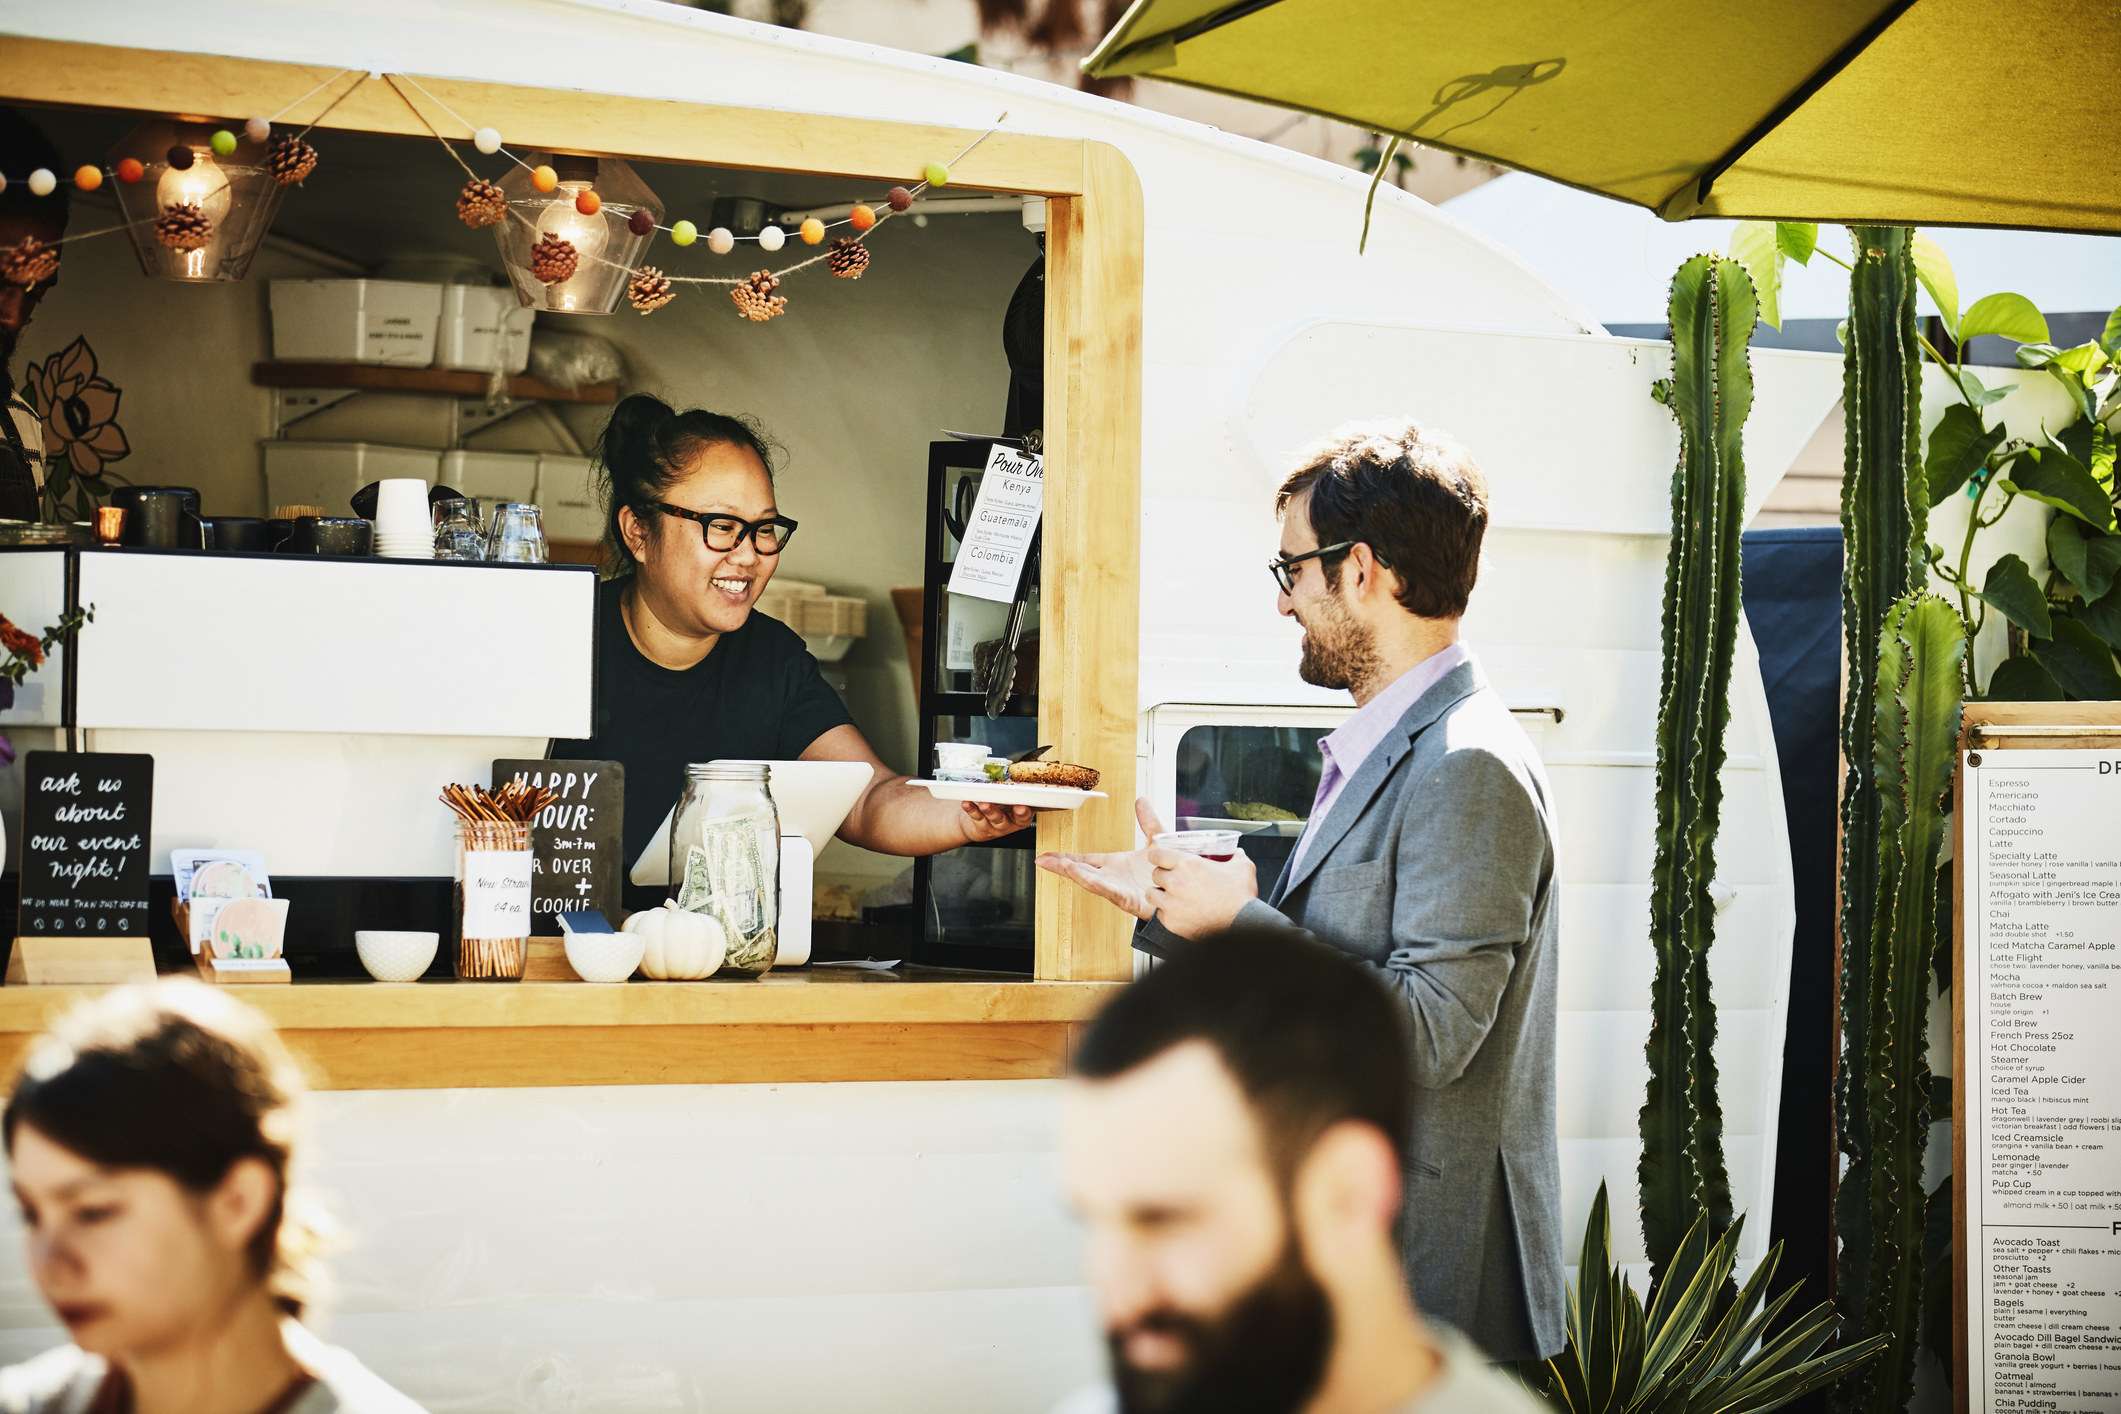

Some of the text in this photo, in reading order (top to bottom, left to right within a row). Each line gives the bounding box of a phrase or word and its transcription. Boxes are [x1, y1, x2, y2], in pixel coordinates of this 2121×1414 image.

[992, 452, 1043, 479] Pour Ove
[1002, 479, 1032, 497] Kenya
[980, 510, 1028, 529] Guatemala
[970, 547, 1014, 564] Colombia
[40, 772, 122, 795] ask us
[1988, 779, 2030, 788] Espresso
[1988, 791, 2039, 800] Americano
[1989, 803, 2036, 812] Macchiato
[55, 801, 127, 824] about
[1988, 815, 2027, 824] Cortado
[1988, 827, 2044, 837] Cappuccino
[31, 834, 142, 851] our event
[1989, 840, 2013, 848] Latte
[1989, 852, 2058, 861] Specialty Latte
[552, 857, 592, 874] OVER
[49, 856, 126, 889] nights!
[1989, 871, 2057, 880] Seasonal Latte
[1989, 890, 2030, 900] Affogato
[2032, 890, 2053, 899] with
[2054, 890, 2081, 900] Jeni's
[2083, 890, 2097, 900] Ice
[49, 898, 70, 907] MORE
[74, 899, 97, 909] THAN
[99, 900, 118, 909] JUST
[1989, 910, 2010, 918] Chai
[1990, 922, 2050, 931] Matcha Latte
[1990, 941, 2116, 951] Iced Matcha Caramel Apple
[1990, 953, 2043, 963] Latte Flight
[1990, 973, 2021, 982] Mocha
[1990, 992, 2043, 1001] Batch Brew
[1990, 1019, 2038, 1028] Cold Brew
[1990, 1031, 2074, 1040] French Press 25oz
[1990, 1043, 2056, 1052] Hot Chocolate
[1990, 1055, 2029, 1064] Steamer
[1990, 1064, 2016, 1072] choice
[2015, 1064, 2024, 1072] of
[1990, 1074, 2086, 1085] Caramel Apple Cider
[1991, 1087, 2029, 1096] Iced Tea
[2042, 1096, 2072, 1104] hibiscus
[2072, 1096, 2089, 1104] mint
[1991, 1106, 2026, 1115] Hot Tea
[2062, 1123, 2078, 1131] odd
[2079, 1123, 2105, 1131] flowers
[1991, 1133, 2064, 1142] Iced Creamsicle
[1991, 1142, 2023, 1150] orangina
[1992, 1152, 2041, 1162] Lemonade
[2009, 1162, 2033, 1170] ginger
[1992, 1179, 2032, 1189] Pup Cup
[1992, 1237, 2060, 1247] Avocado Toast
[1992, 1254, 2030, 1262] prosciutto
[1992, 1264, 2052, 1274] Other Toasts
[2025, 1274, 2039, 1282] jam
[2014, 1281, 2031, 1289] goat
[2032, 1281, 2058, 1289] cheese
[2032, 1289, 2054, 1297] honey
[1994, 1298, 2024, 1308] Bagels
[2049, 1309, 2088, 1317] everything
[2017, 1322, 2042, 1330] cheese
[2084, 1324, 2110, 1332] cheese
[1994, 1332, 2035, 1342] Avocado
[2037, 1333, 2052, 1342] Dill
[2054, 1333, 2081, 1344] Bagel
[1994, 1341, 2012, 1349] plain
[2012, 1342, 2033, 1350] bagel
[2041, 1342, 2053, 1350] dill
[2077, 1343, 2103, 1351] cheese
[1994, 1351, 2056, 1362] Granola Bowl
[2018, 1362, 2039, 1370] greek
[1994, 1371, 2034, 1381] Oatmeal
[2029, 1381, 2056, 1389] almond
[1994, 1388, 2112, 1398] bananas strawberries bananas
[1995, 1398, 2057, 1410] Chia Pudding
